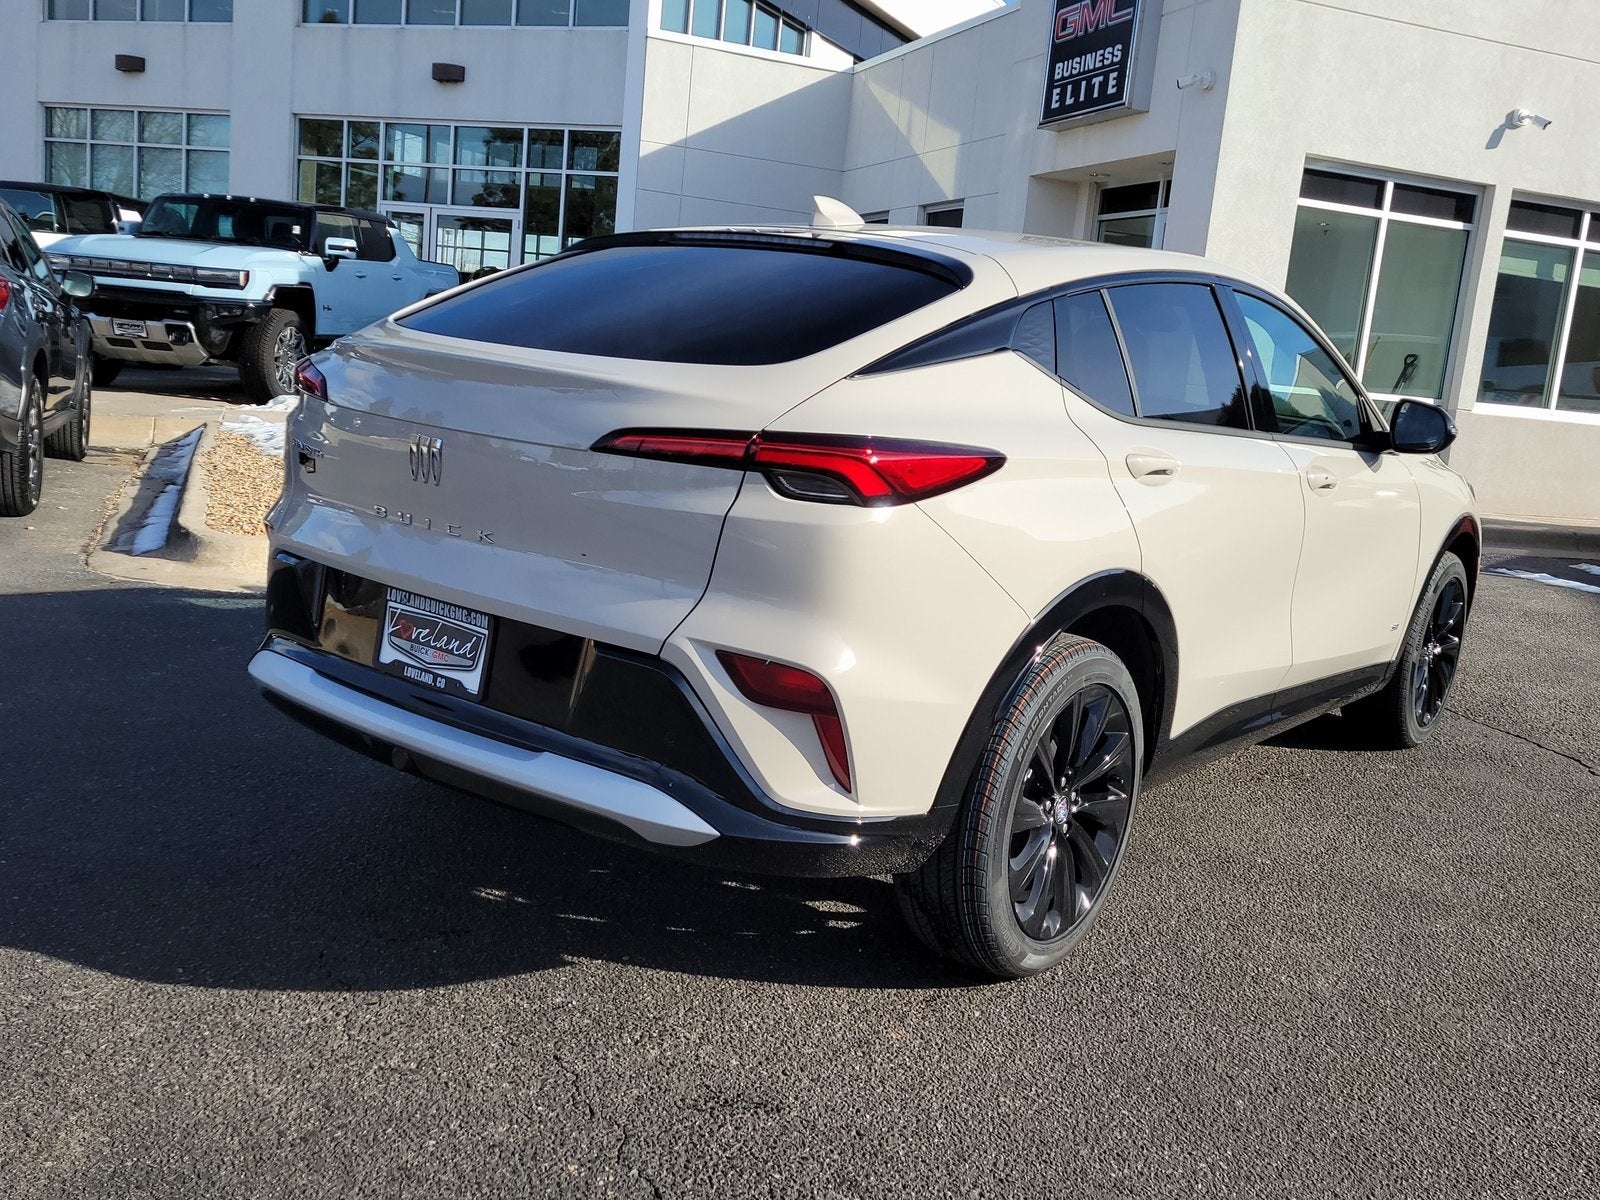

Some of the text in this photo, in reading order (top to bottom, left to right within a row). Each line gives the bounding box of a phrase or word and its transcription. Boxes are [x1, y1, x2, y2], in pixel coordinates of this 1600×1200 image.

[1054, 44, 1122, 80] BUSINESS
[1051, 72, 1118, 109] ELITE
[374, 504, 495, 544] BUICK
[409, 643, 449, 662] BUICK GMC
[403, 665, 446, 688] LOVELAND, CO
